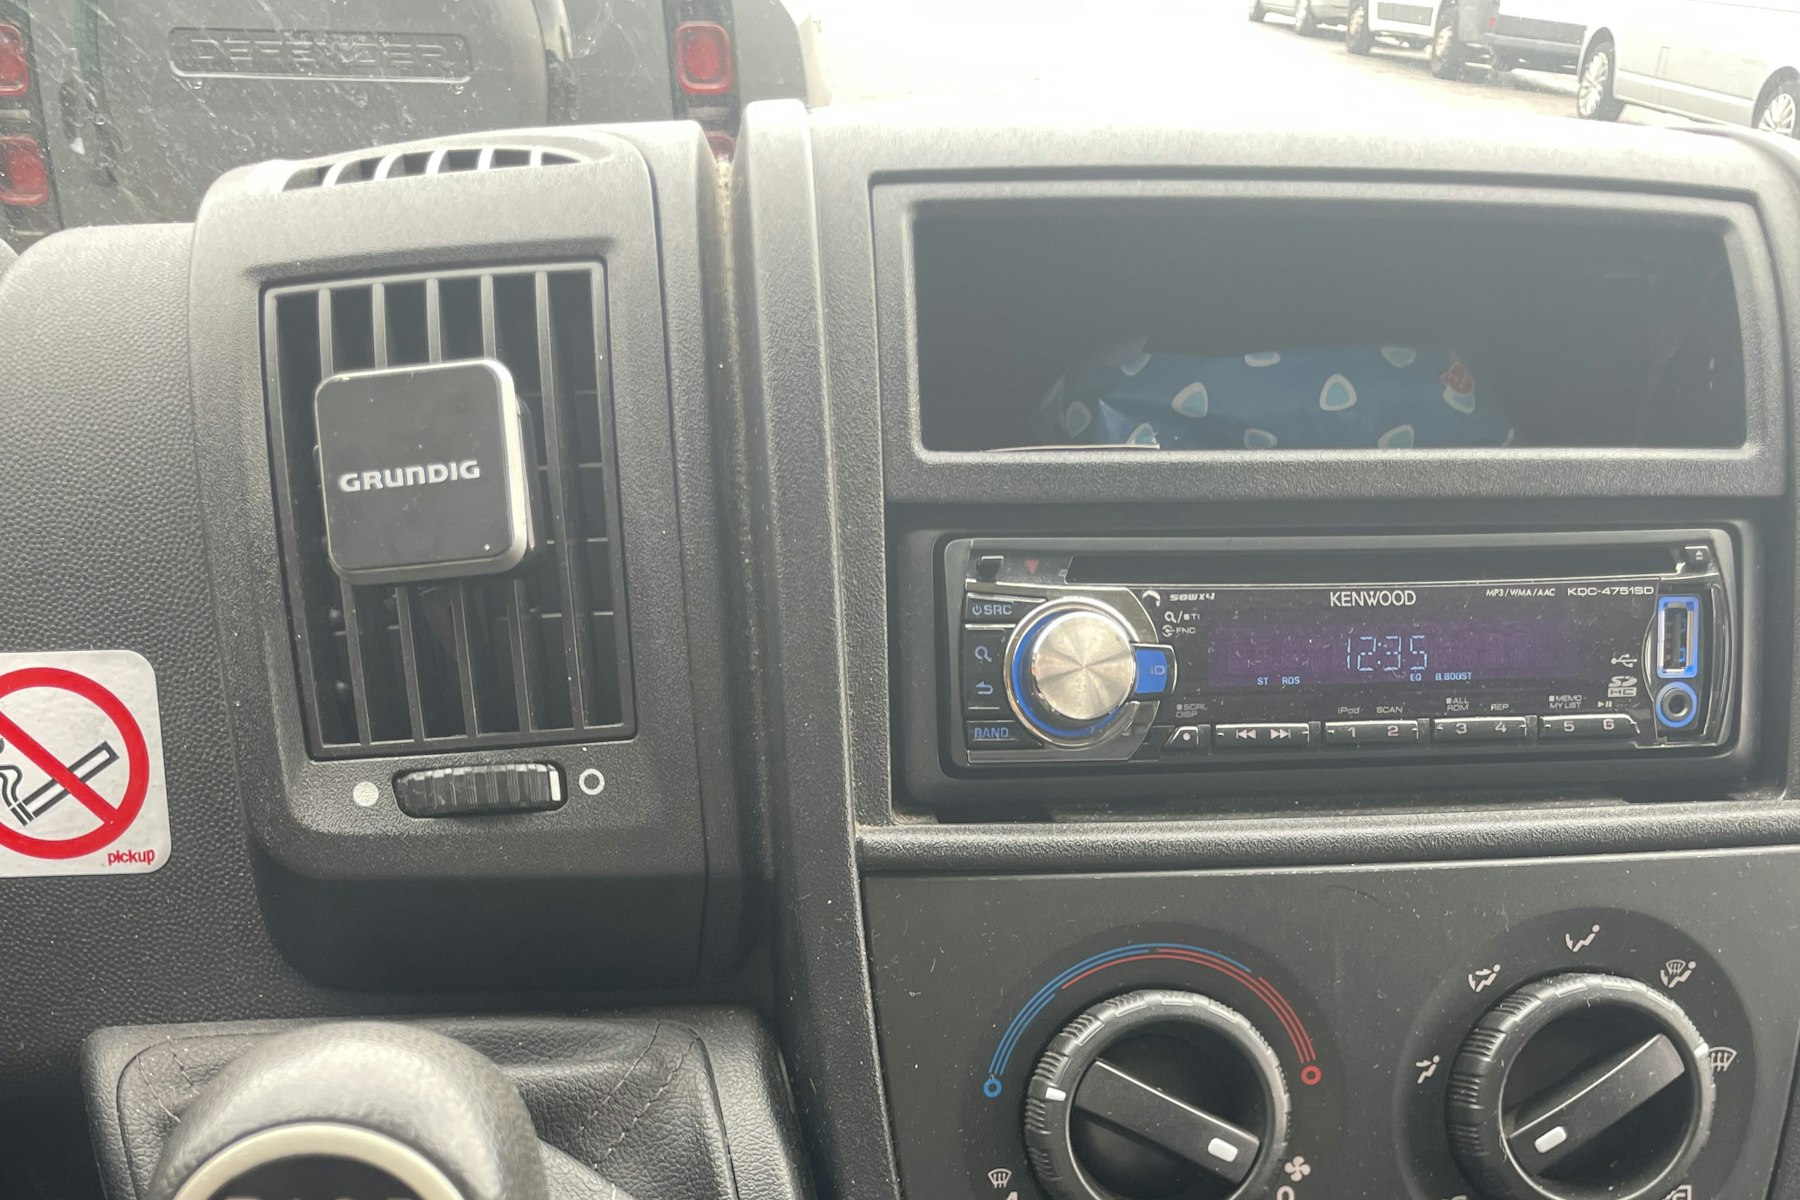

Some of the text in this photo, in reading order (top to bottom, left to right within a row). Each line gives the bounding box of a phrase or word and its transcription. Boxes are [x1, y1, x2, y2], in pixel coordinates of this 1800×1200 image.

[339, 460, 480, 492] GRUNDIG
[1567, 586, 1654, 596] KDC-4751SD
[1329, 590, 1416, 607] KENWOOD
[983, 604, 1012, 616] SRC
[1176, 626, 1196, 635] FNC
[1346, 634, 1428, 672] 12:35
[1256, 676, 1269, 686] ST
[1281, 675, 1301, 685] RDS
[1410, 672, 1422, 682] EQ
[1337, 706, 1360, 715] iPod
[1376, 706, 1403, 714] SCAN
[1490, 703, 1509, 711] REP
[1549, 702, 1583, 710] MY LIST
[1455, 722, 1468, 735] 3
[1494, 721, 1507, 733] 4
[1563, 721, 1575, 732] 5
[1602, 719, 1615, 730] 6
[974, 727, 1009, 739] BAND
[1348, 729, 1356, 738] 1
[1387, 725, 1399, 737] 2
[107, 849, 156, 866] pickup
